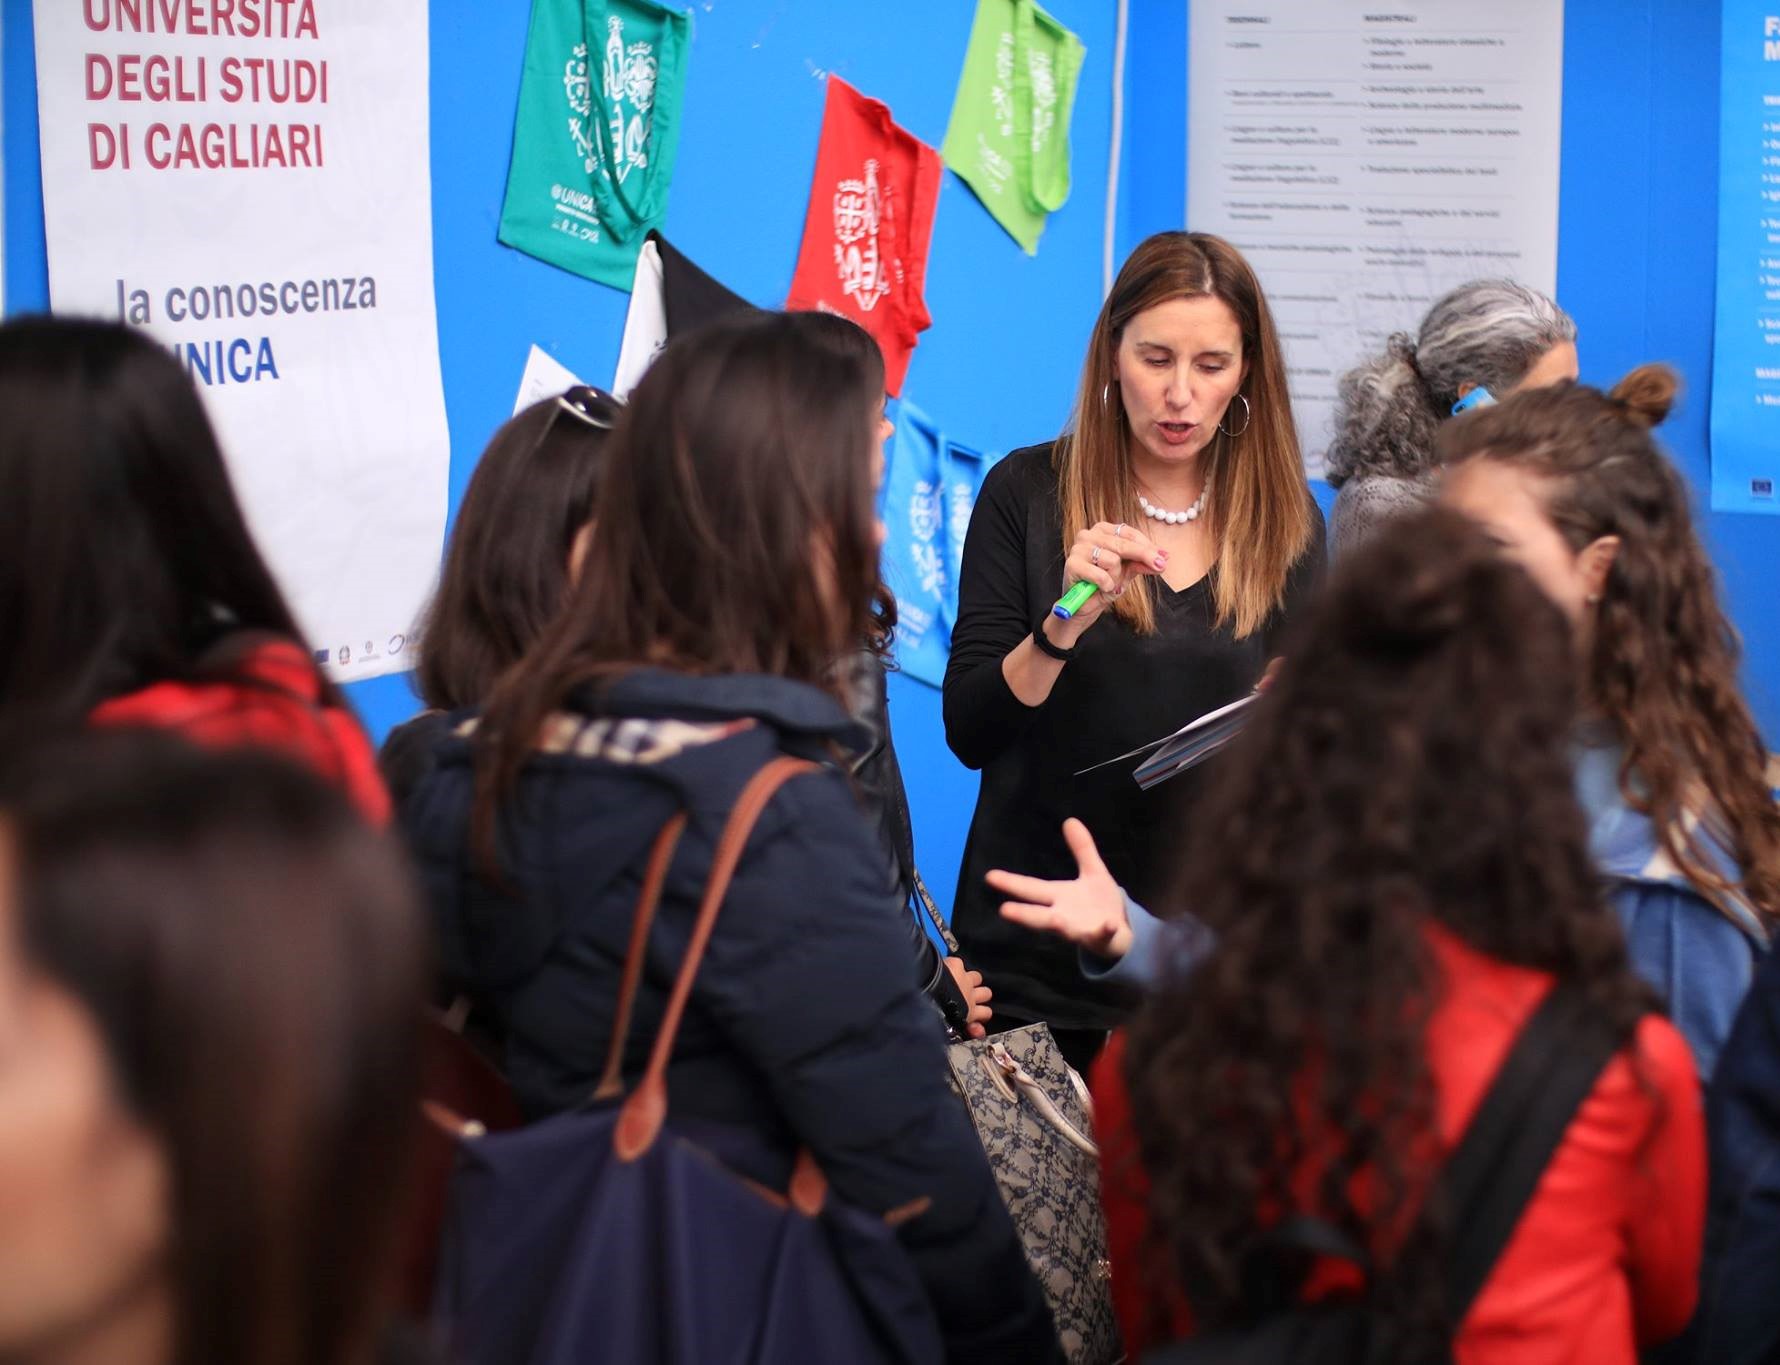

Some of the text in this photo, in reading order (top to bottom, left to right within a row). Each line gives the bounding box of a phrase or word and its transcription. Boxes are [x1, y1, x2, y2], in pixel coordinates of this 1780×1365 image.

[85, 53, 328, 103] DEGLI STUDI
[88, 123, 324, 170] DI CAGLIARI
[116, 275, 377, 325] la conoscenza
[175, 337, 279, 385] NICA
